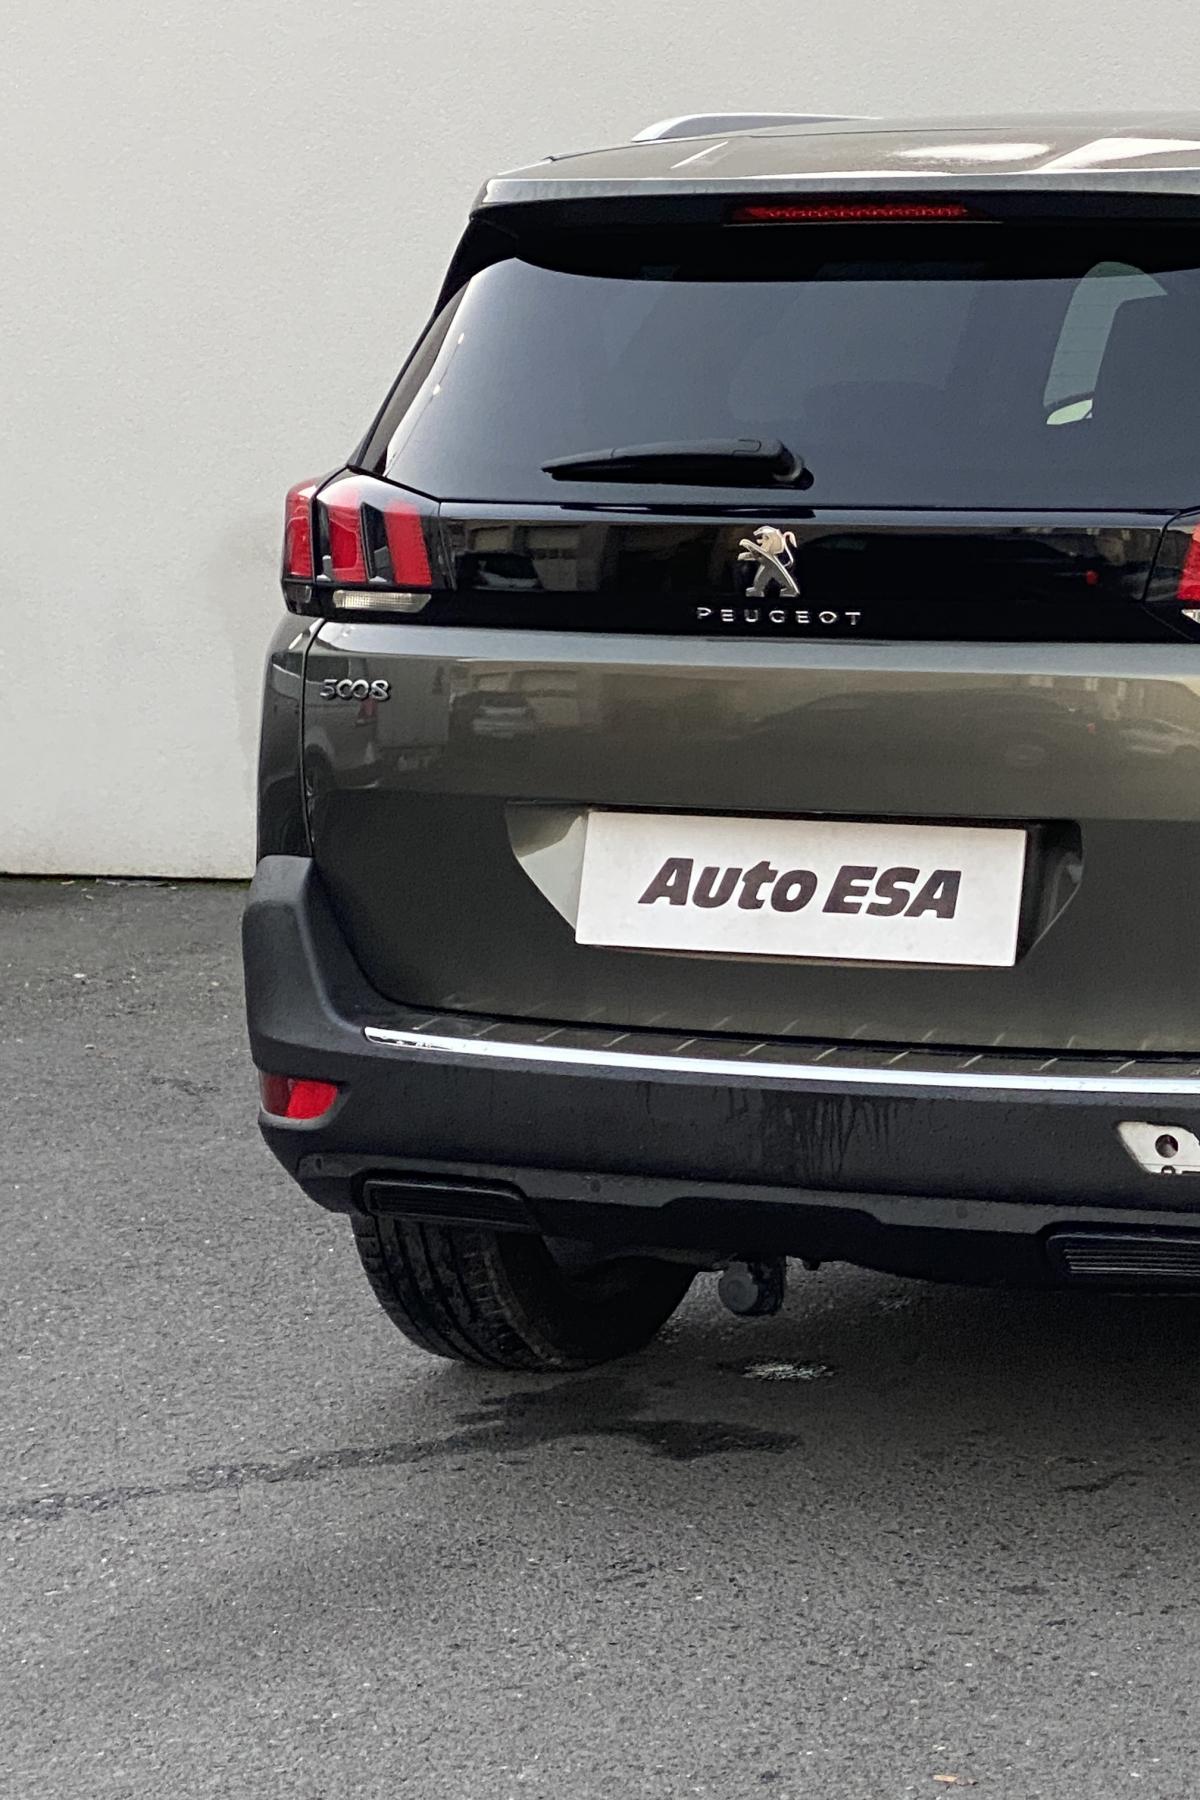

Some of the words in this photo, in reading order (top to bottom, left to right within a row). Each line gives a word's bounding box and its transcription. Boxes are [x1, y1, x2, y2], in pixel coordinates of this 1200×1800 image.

[696, 606, 861, 626] PEUGEOT
[319, 678, 390, 701] 5008
[637, 856, 818, 913] Auto
[822, 864, 963, 920] ESA
